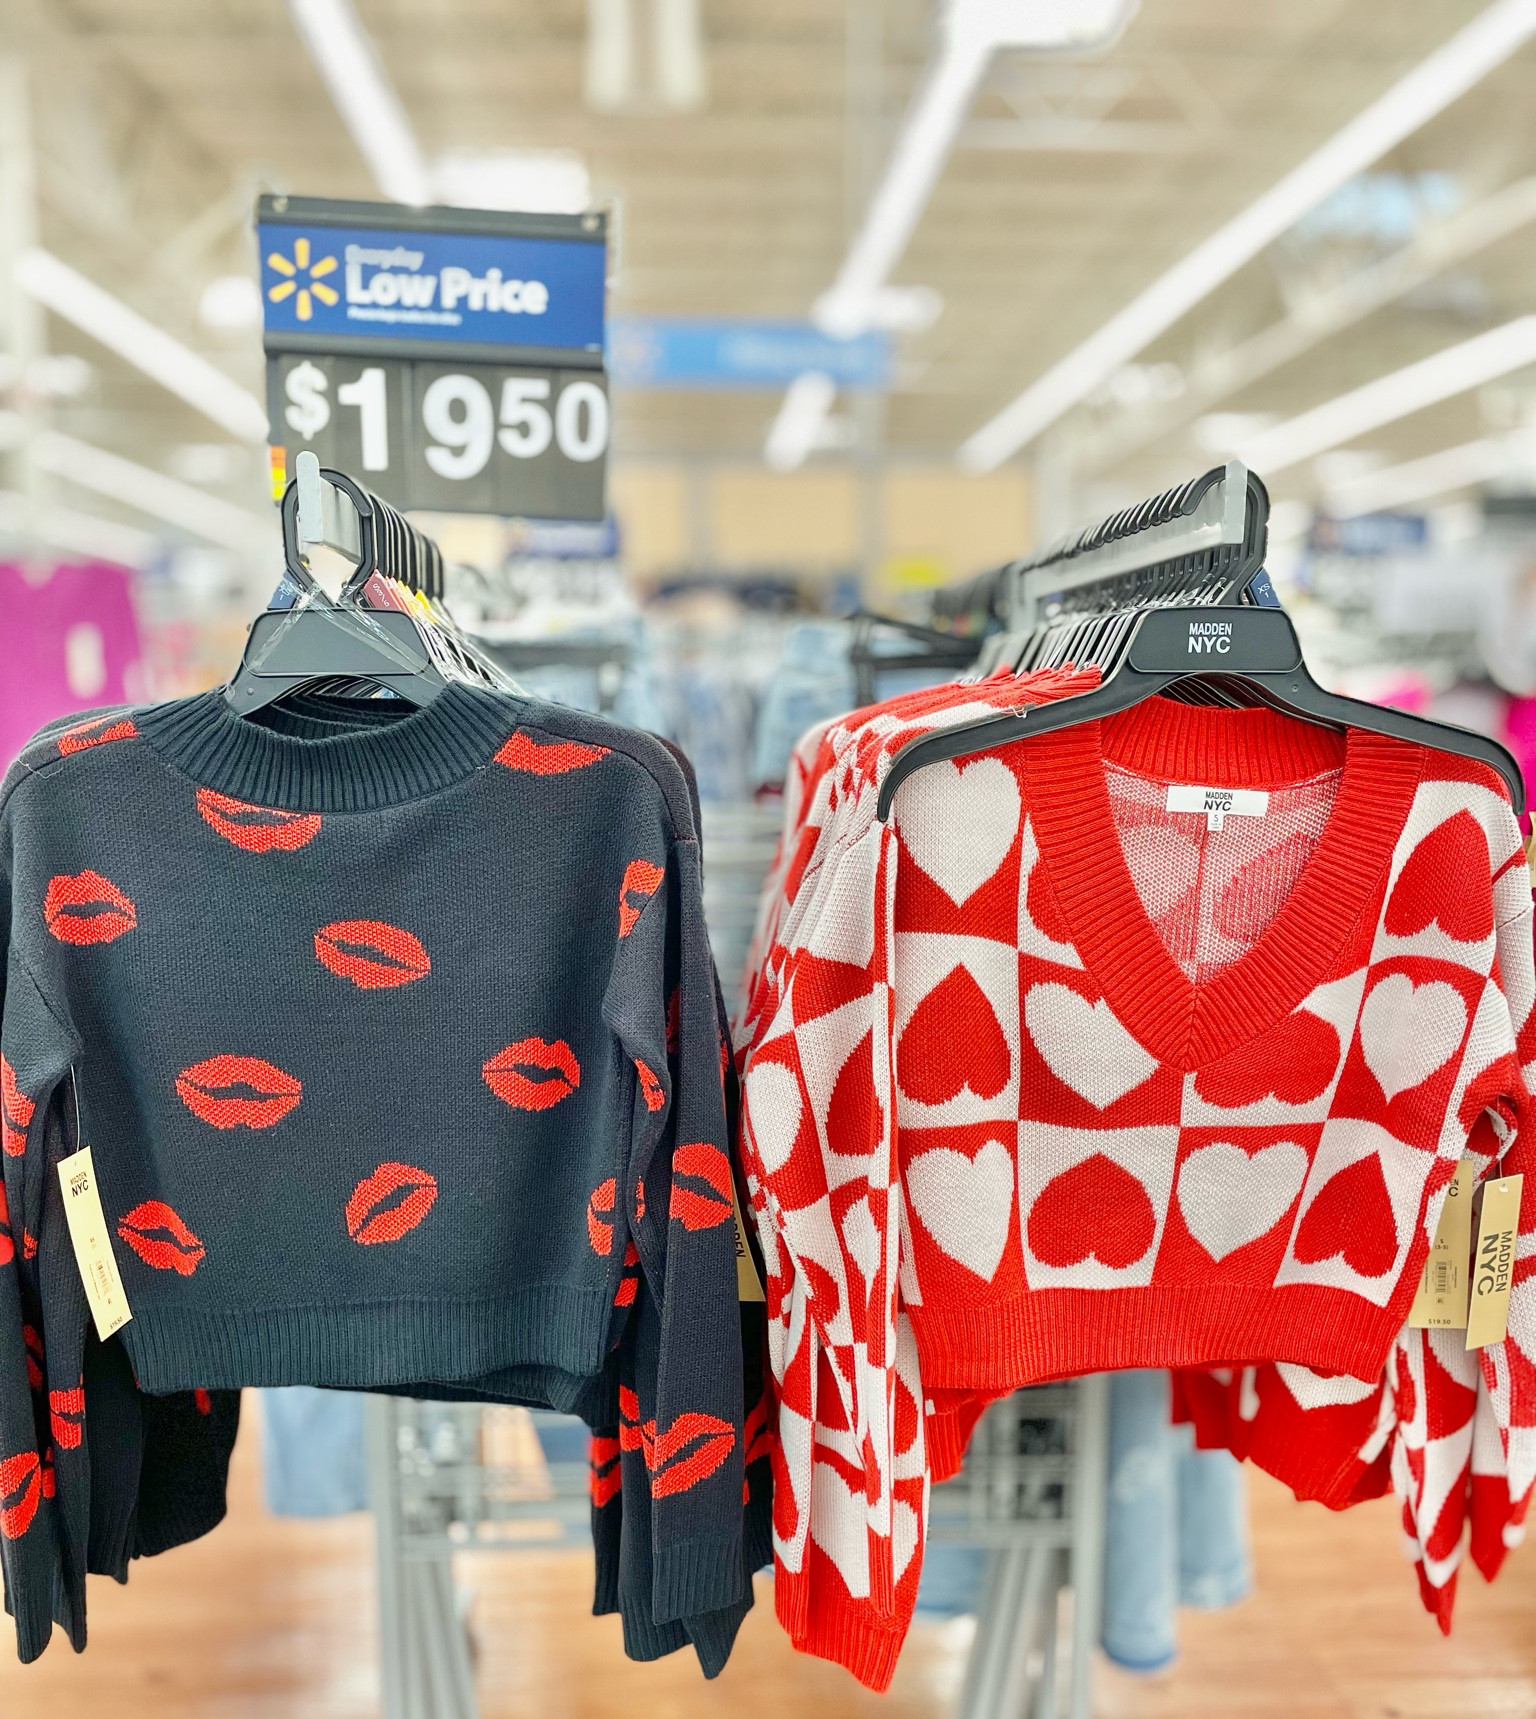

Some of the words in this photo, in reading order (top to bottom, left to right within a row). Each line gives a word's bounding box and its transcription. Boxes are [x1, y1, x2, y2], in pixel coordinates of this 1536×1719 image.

[345, 262, 438, 308] Low
[440, 266, 549, 315] Price
[1257, 582, 1270, 595] XS
[1189, 622, 1233, 636] MADDEN
[1188, 636, 1231, 654] NYC
[1205, 791, 1233, 801] MADDEN
[1203, 800, 1232, 812] NYC
[1213, 814, 1219, 822] S
[69, 1171, 87, 1185] MADDEN
[72, 1179, 89, 1197] NYC
[1477, 1233, 1500, 1296] NYC
[1495, 1230, 1513, 1293] MADDEN
